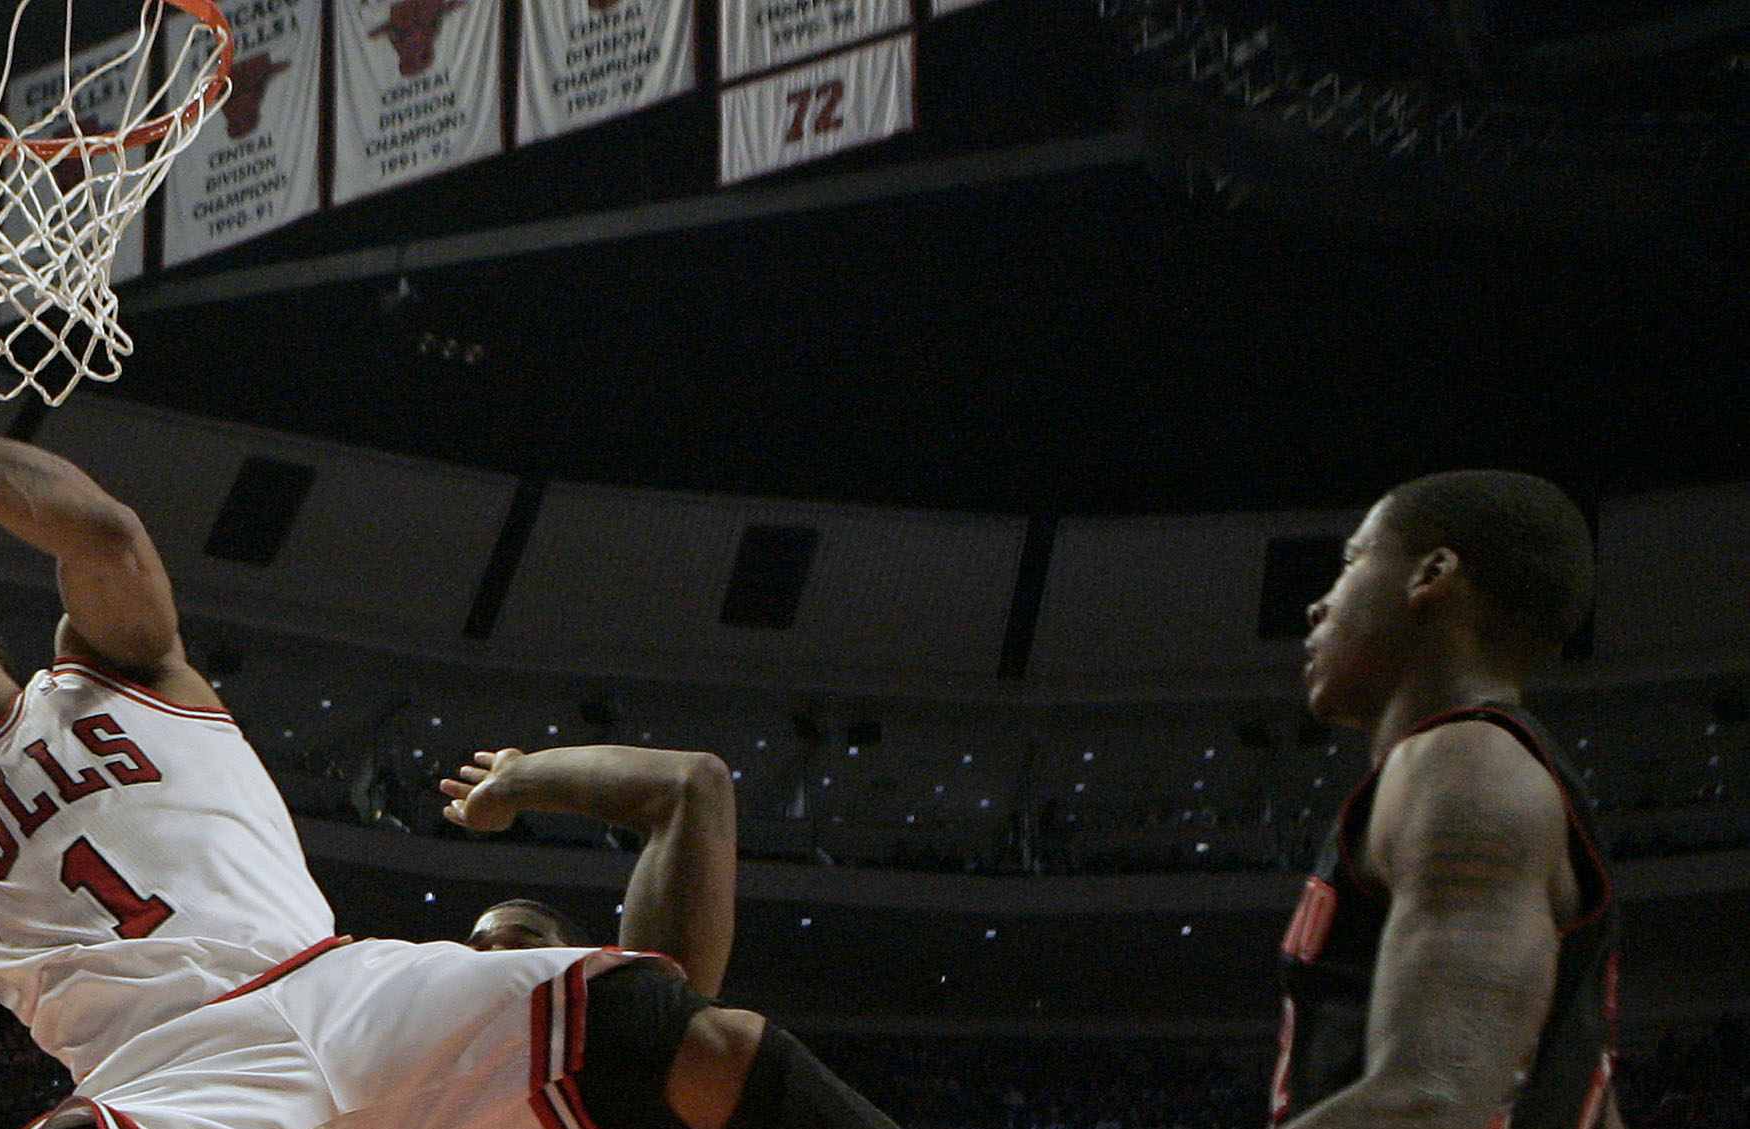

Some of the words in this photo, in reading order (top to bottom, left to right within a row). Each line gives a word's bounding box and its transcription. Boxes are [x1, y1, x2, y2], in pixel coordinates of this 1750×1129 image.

[569, 5, 642, 40] CENTRAL
[565, 26, 646, 66] DIVISION
[380, 66, 450, 105] CENTRAL
[552, 45, 661, 96] CHAMPIONS
[379, 91, 456, 130] DIVISION
[785, 79, 844, 143] 72
[208, 130, 273, 170] CENTRAL
[365, 110, 466, 158] CHAMPIONS
[205, 153, 277, 193] DIVISION
[193, 173, 287, 221] CHAMPIONS
[209, 200, 274, 239] 1990-91
[59, 834, 177, 940] 1
